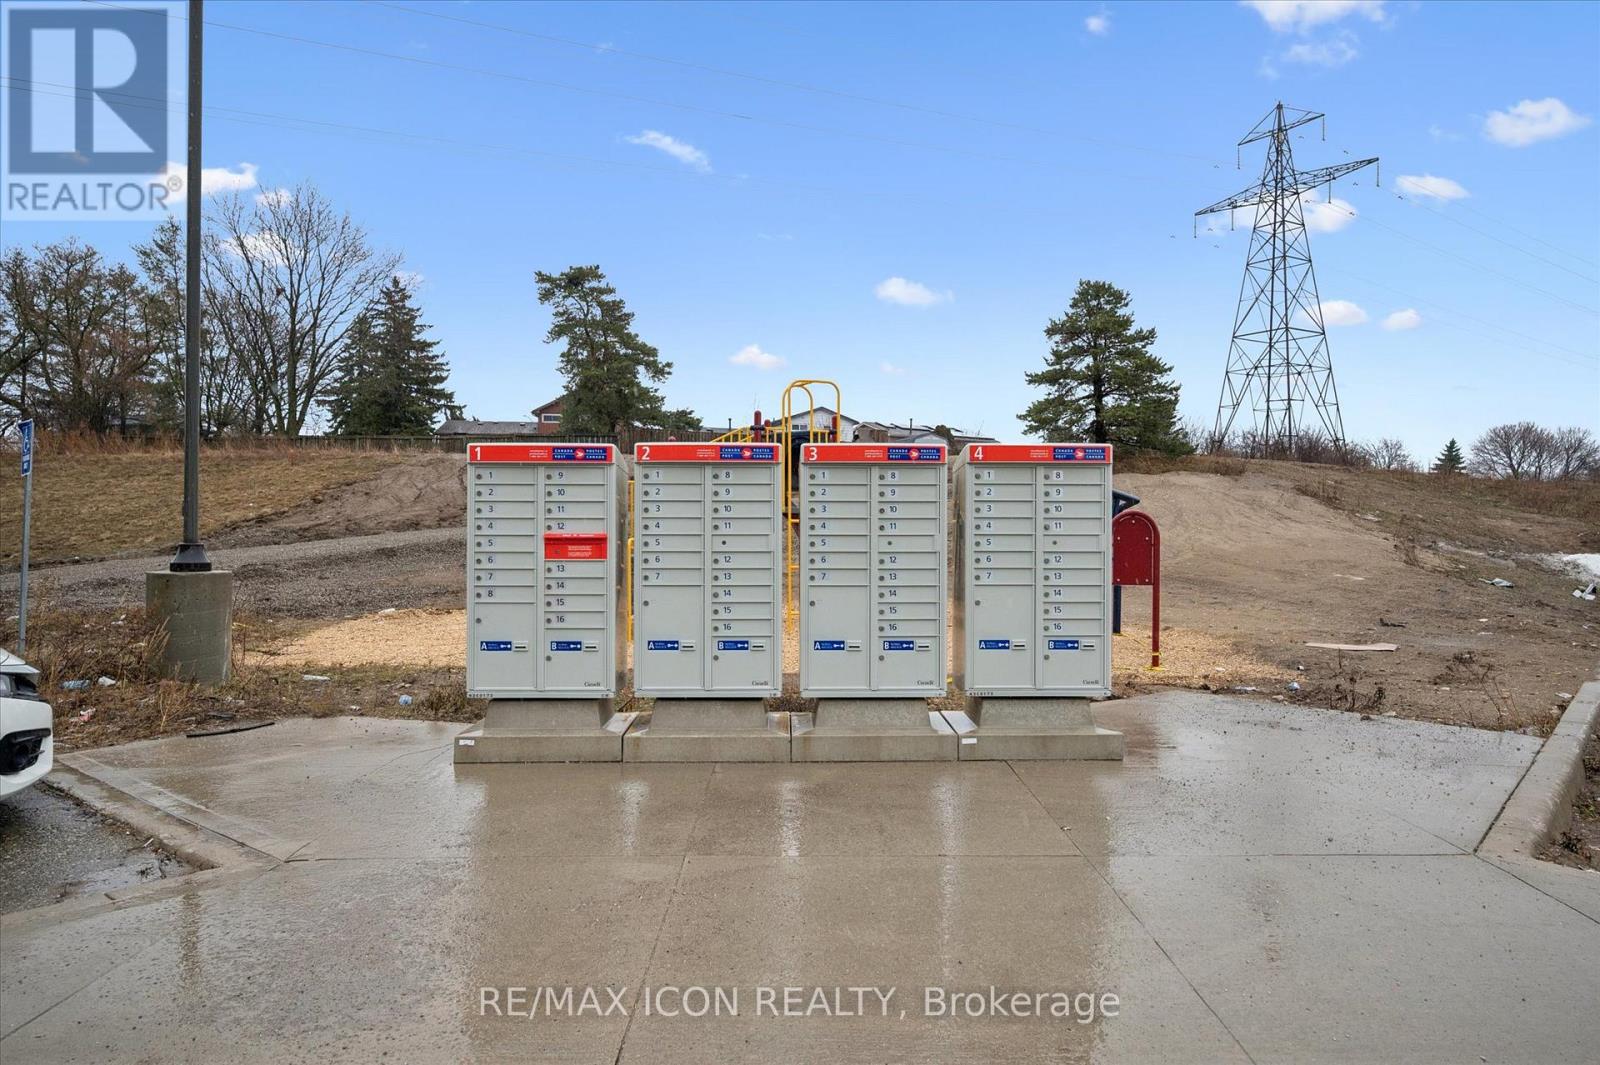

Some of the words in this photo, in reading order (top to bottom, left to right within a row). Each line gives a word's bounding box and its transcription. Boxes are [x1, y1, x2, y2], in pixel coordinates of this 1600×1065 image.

[474, 447, 481, 460] 1
[641, 446, 650, 460] 2
[808, 447, 818, 461] 3
[974, 446, 984, 460] 4
[725, 471, 731, 479] 8
[488, 488, 494, 496] 2
[557, 488, 566, 496] 10
[655, 488, 661, 496] 2
[725, 488, 731, 496] 9
[821, 488, 826, 496] 2
[987, 488, 992, 496] 2
[1056, 488, 1061, 496] 9
[489, 505, 494, 513] 3
[557, 505, 565, 513] 11
[656, 504, 661, 512] 3
[724, 505, 732, 513] 10
[822, 505, 827, 513] 3
[1054, 505, 1062, 513] 10
[557, 522, 565, 530] 12
[890, 522, 897, 530] 11
[488, 539, 493, 547] 5
[655, 538, 660, 546] 5
[821, 538, 826, 547] 5
[986, 538, 992, 546] 5
[488, 556, 494, 564] 6
[655, 555, 661, 563] 6
[724, 555, 732, 563] 12
[821, 555, 827, 563] 6
[889, 556, 897, 564] 12
[986, 555, 992, 563] 6
[1054, 555, 1062, 563] 12
[557, 564, 565, 573] 13
[488, 572, 493, 580] 7
[656, 572, 660, 580] 7
[724, 572, 732, 580] 13
[821, 572, 826, 580] 7
[889, 572, 897, 581] 13
[1054, 572, 1062, 580] 13
[487, 589, 494, 598] 8
[723, 589, 732, 597] 14
[889, 589, 897, 597] 14
[556, 598, 565, 606] 15
[723, 606, 732, 614] 15
[889, 606, 897, 614] 15
[1054, 606, 1062, 614] 15
[556, 615, 565, 623] 16
[723, 623, 732, 631] 16
[889, 623, 897, 631] 16
[481, 642, 487, 650] A
[551, 642, 557, 650] B
[648, 642, 655, 650] A
[718, 642, 724, 650] B
[814, 641, 821, 650] A
[884, 642, 890, 650] B
[979, 641, 986, 649] A
[1049, 641, 1055, 649] B
